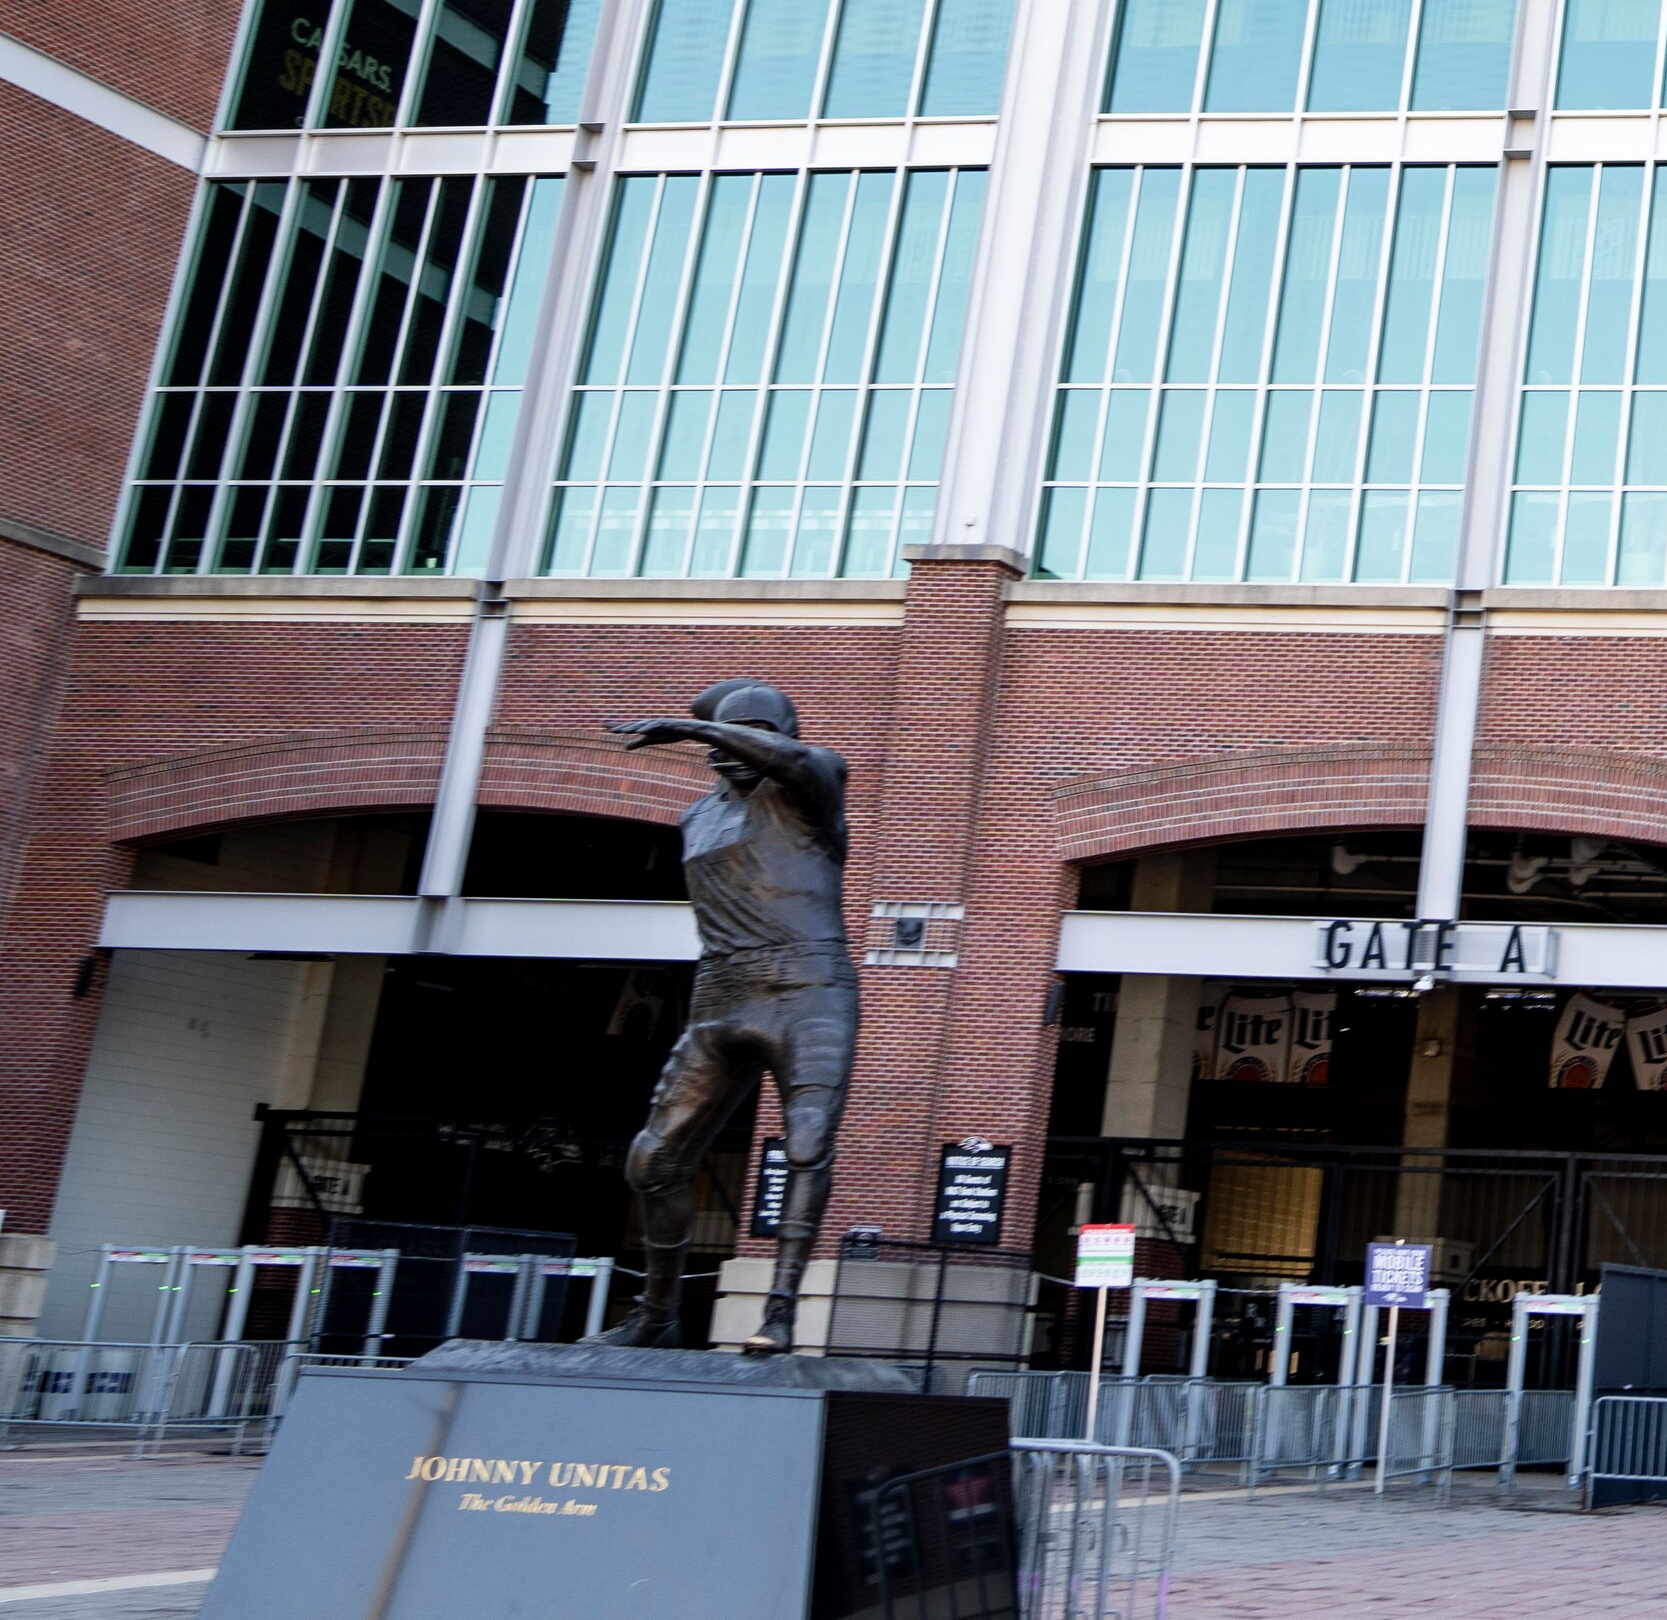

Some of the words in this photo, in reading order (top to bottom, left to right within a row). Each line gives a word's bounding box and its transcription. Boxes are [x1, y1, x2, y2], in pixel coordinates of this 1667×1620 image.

[290, 16, 394, 94] CASARS
[1325, 920, 1457, 970] GATE
[1499, 924, 1526, 973] A
[1223, 1009, 1282, 1054] Lite
[1296, 1007, 1337, 1048] Lit
[1562, 1008, 1622, 1052] Lite
[405, 1455, 543, 1485] JOHNNY
[548, 1462, 672, 1492] UNITAS
[458, 1492, 494, 1512] The
[494, 1494, 559, 1515] Golden
